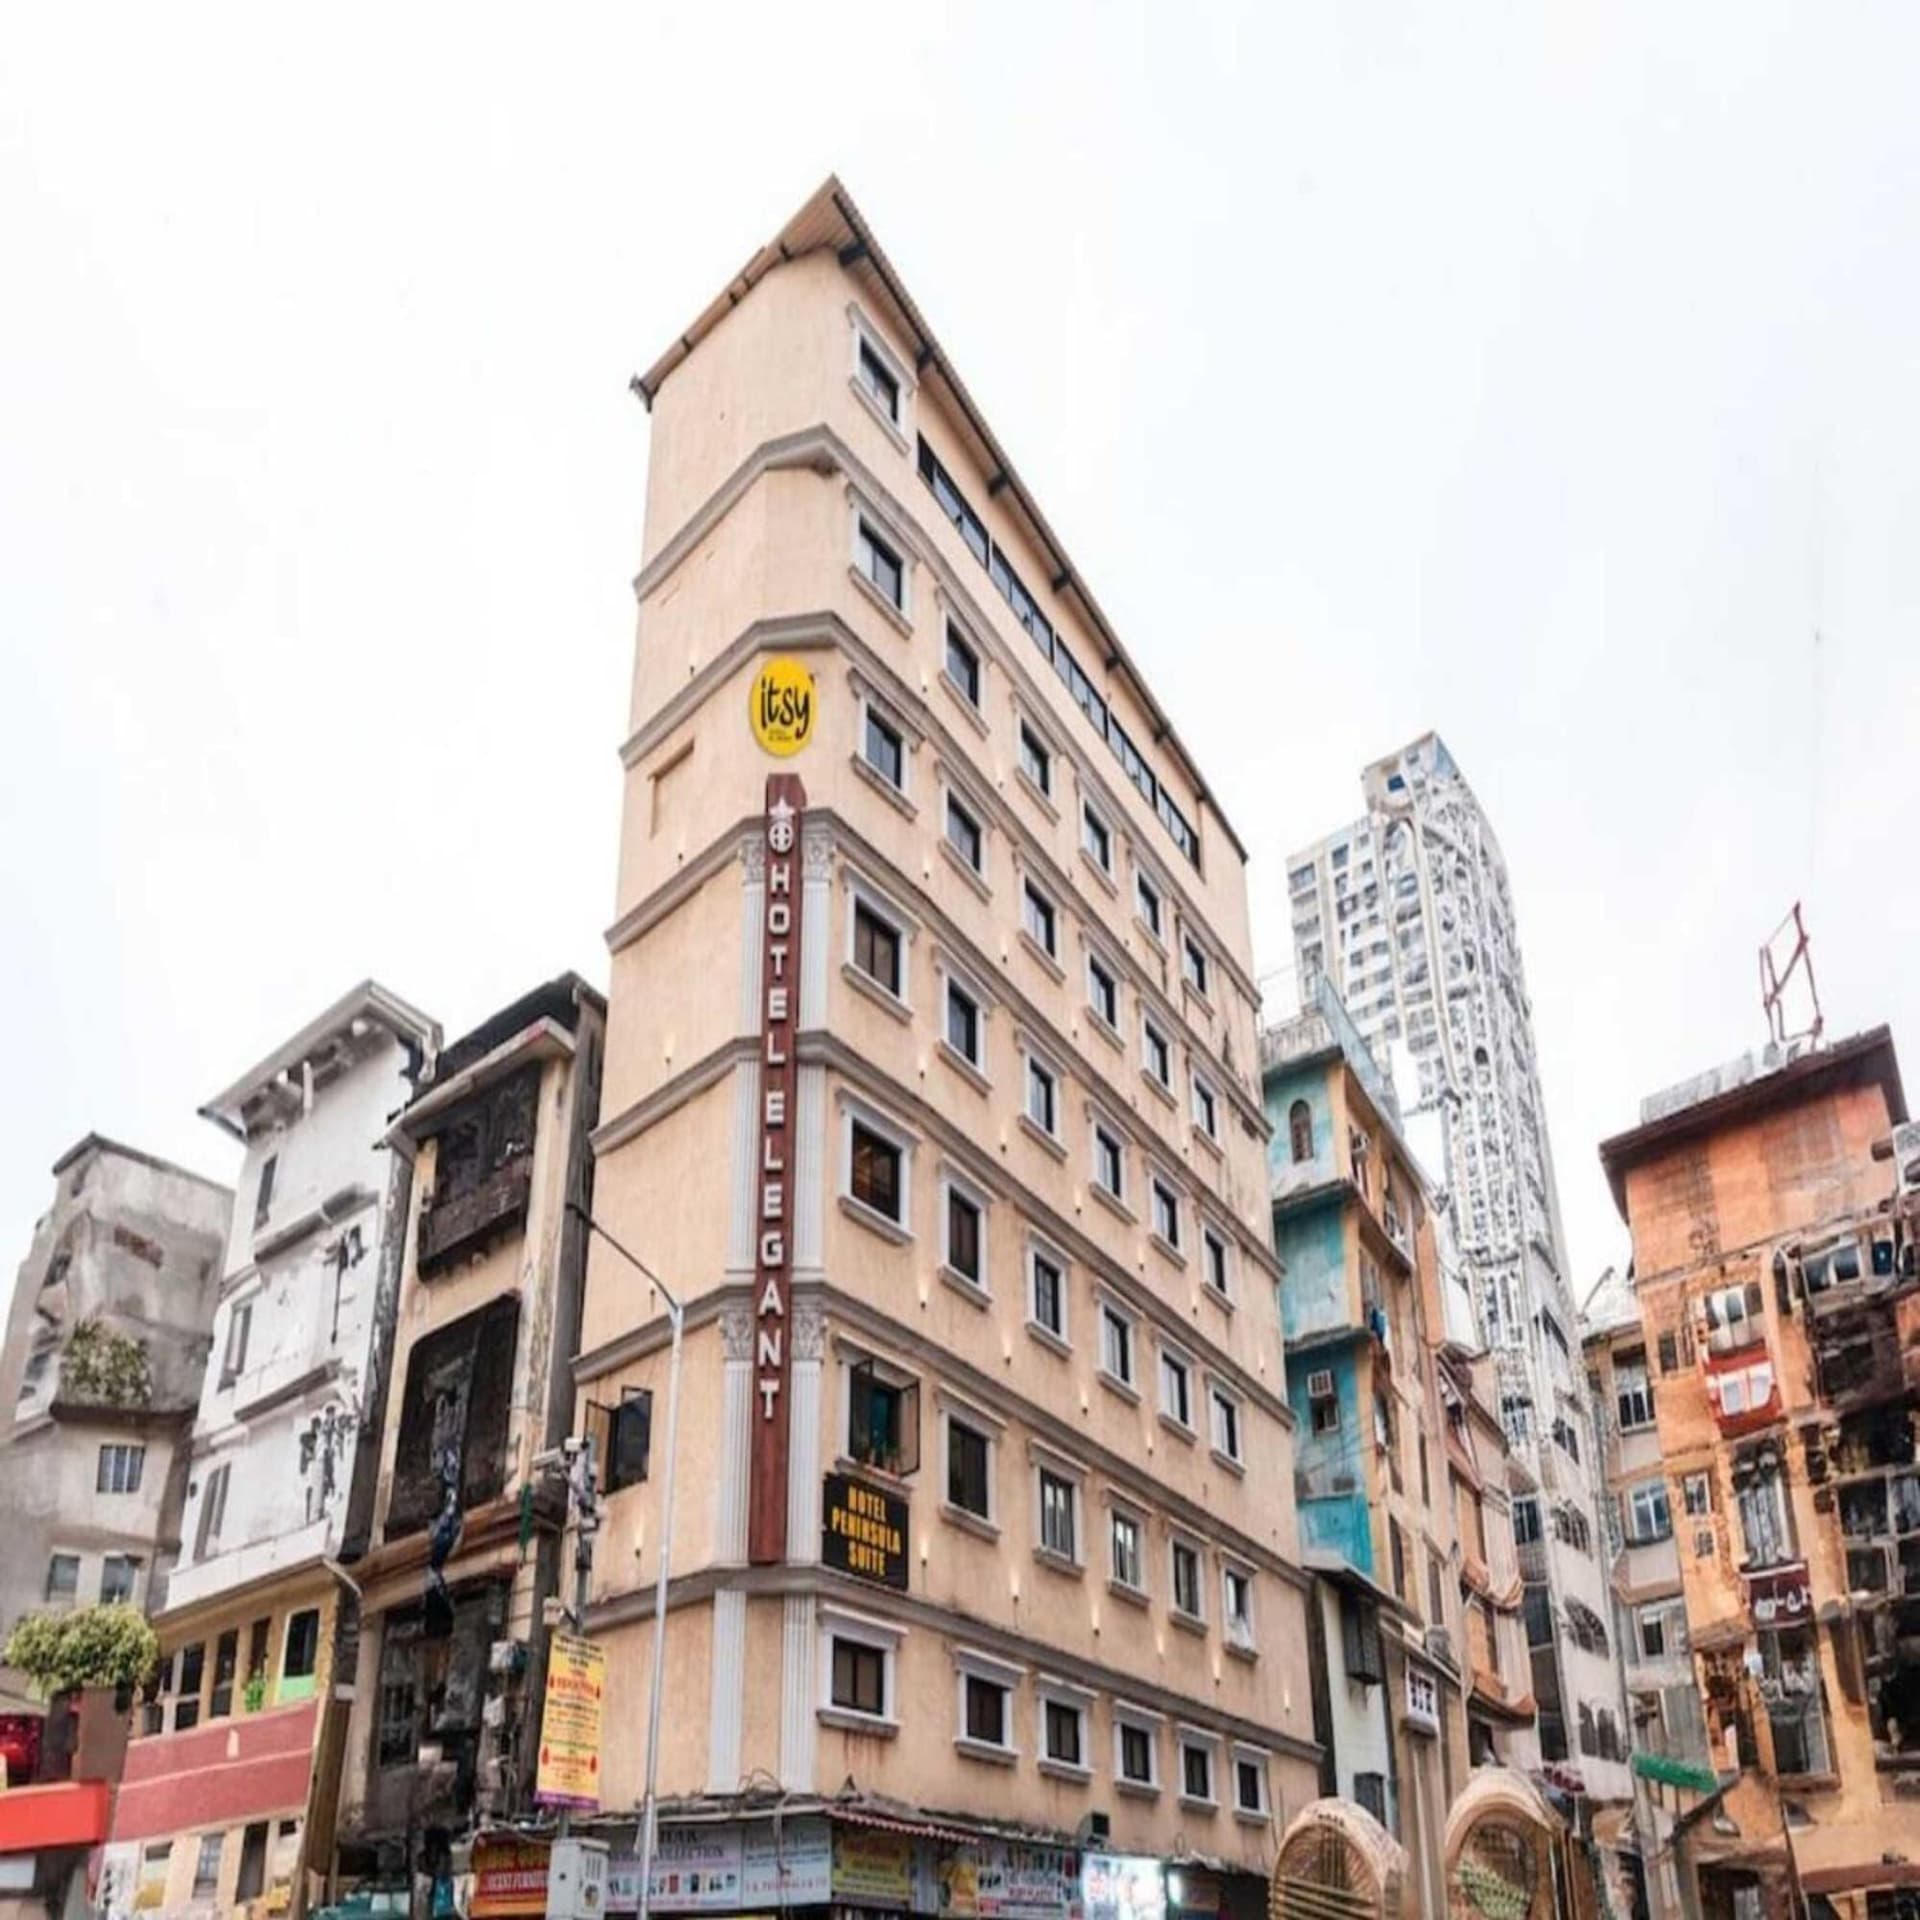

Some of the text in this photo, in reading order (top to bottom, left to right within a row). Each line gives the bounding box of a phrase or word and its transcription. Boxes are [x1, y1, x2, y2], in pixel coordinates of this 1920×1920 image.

[761, 676, 811, 740] itsy
[759, 861, 792, 1419] HOTEL ELEGANT
[848, 1485, 886, 1521] HOTEL
[831, 1506, 901, 1554] PENINSULA
[848, 1540, 886, 1576] SUITE
